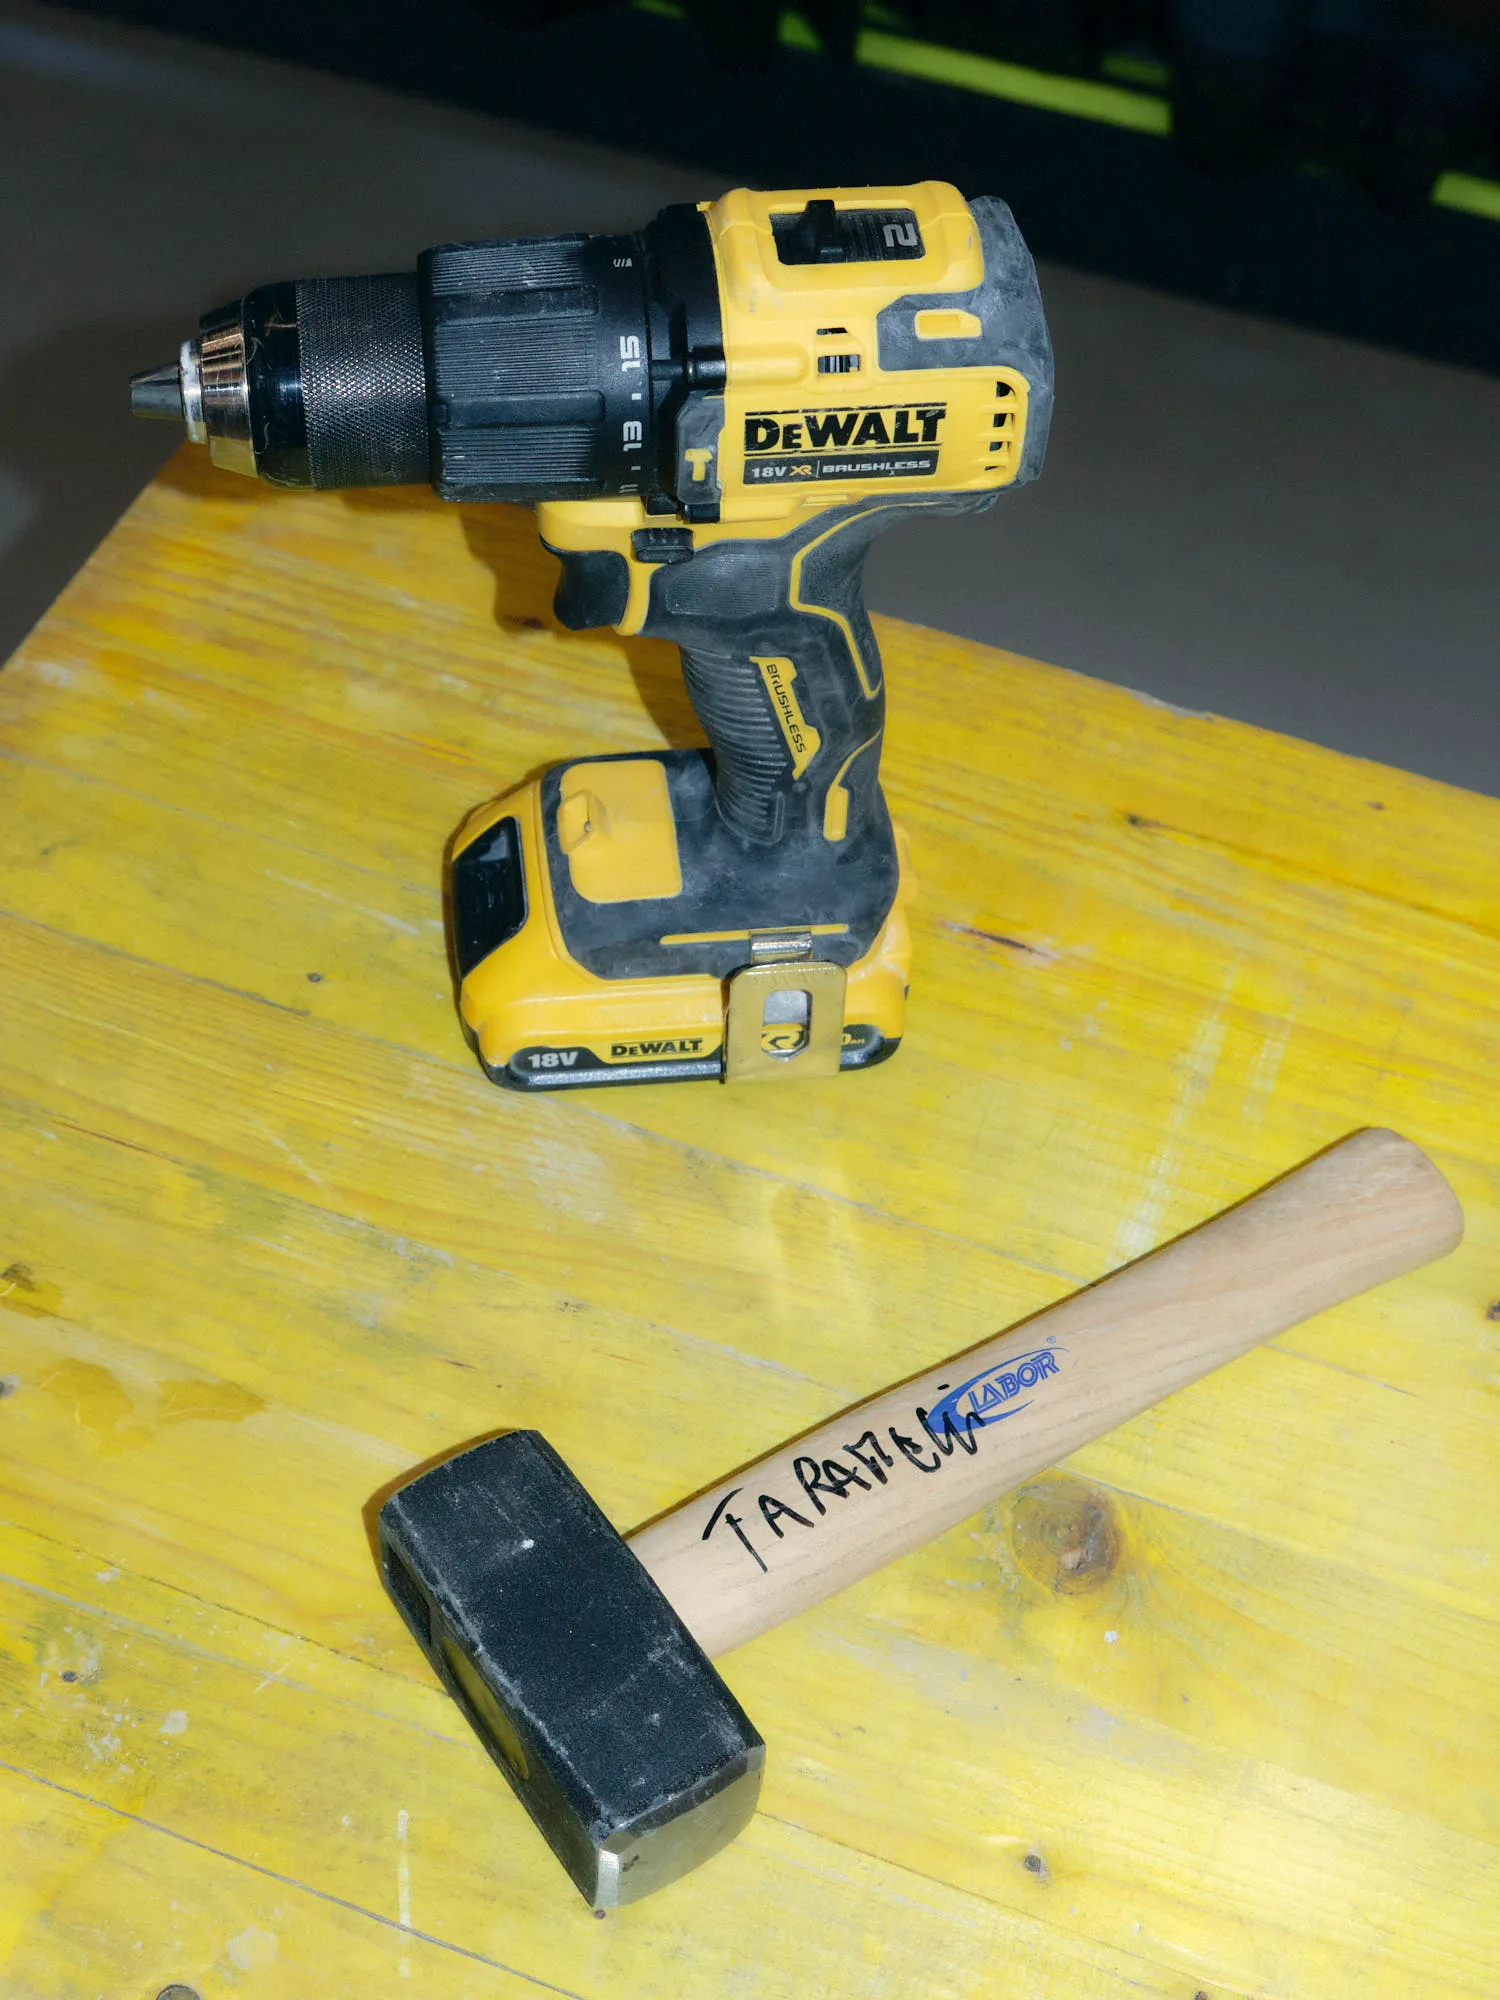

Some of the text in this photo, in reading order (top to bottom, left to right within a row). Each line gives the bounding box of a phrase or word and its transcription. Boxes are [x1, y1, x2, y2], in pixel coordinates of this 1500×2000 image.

[882, 222, 918, 248] 2
[619, 335, 641, 372] 15
[622, 420, 642, 452] 13
[744, 407, 946, 452] DEWALT
[751, 465, 787, 479] 18V
[822, 459, 931, 474] BRUSHLESS
[766, 663, 807, 753] BRUSHLESS
[527, 1050, 579, 1069] 18V
[967, 1351, 1061, 1415] LABOR
